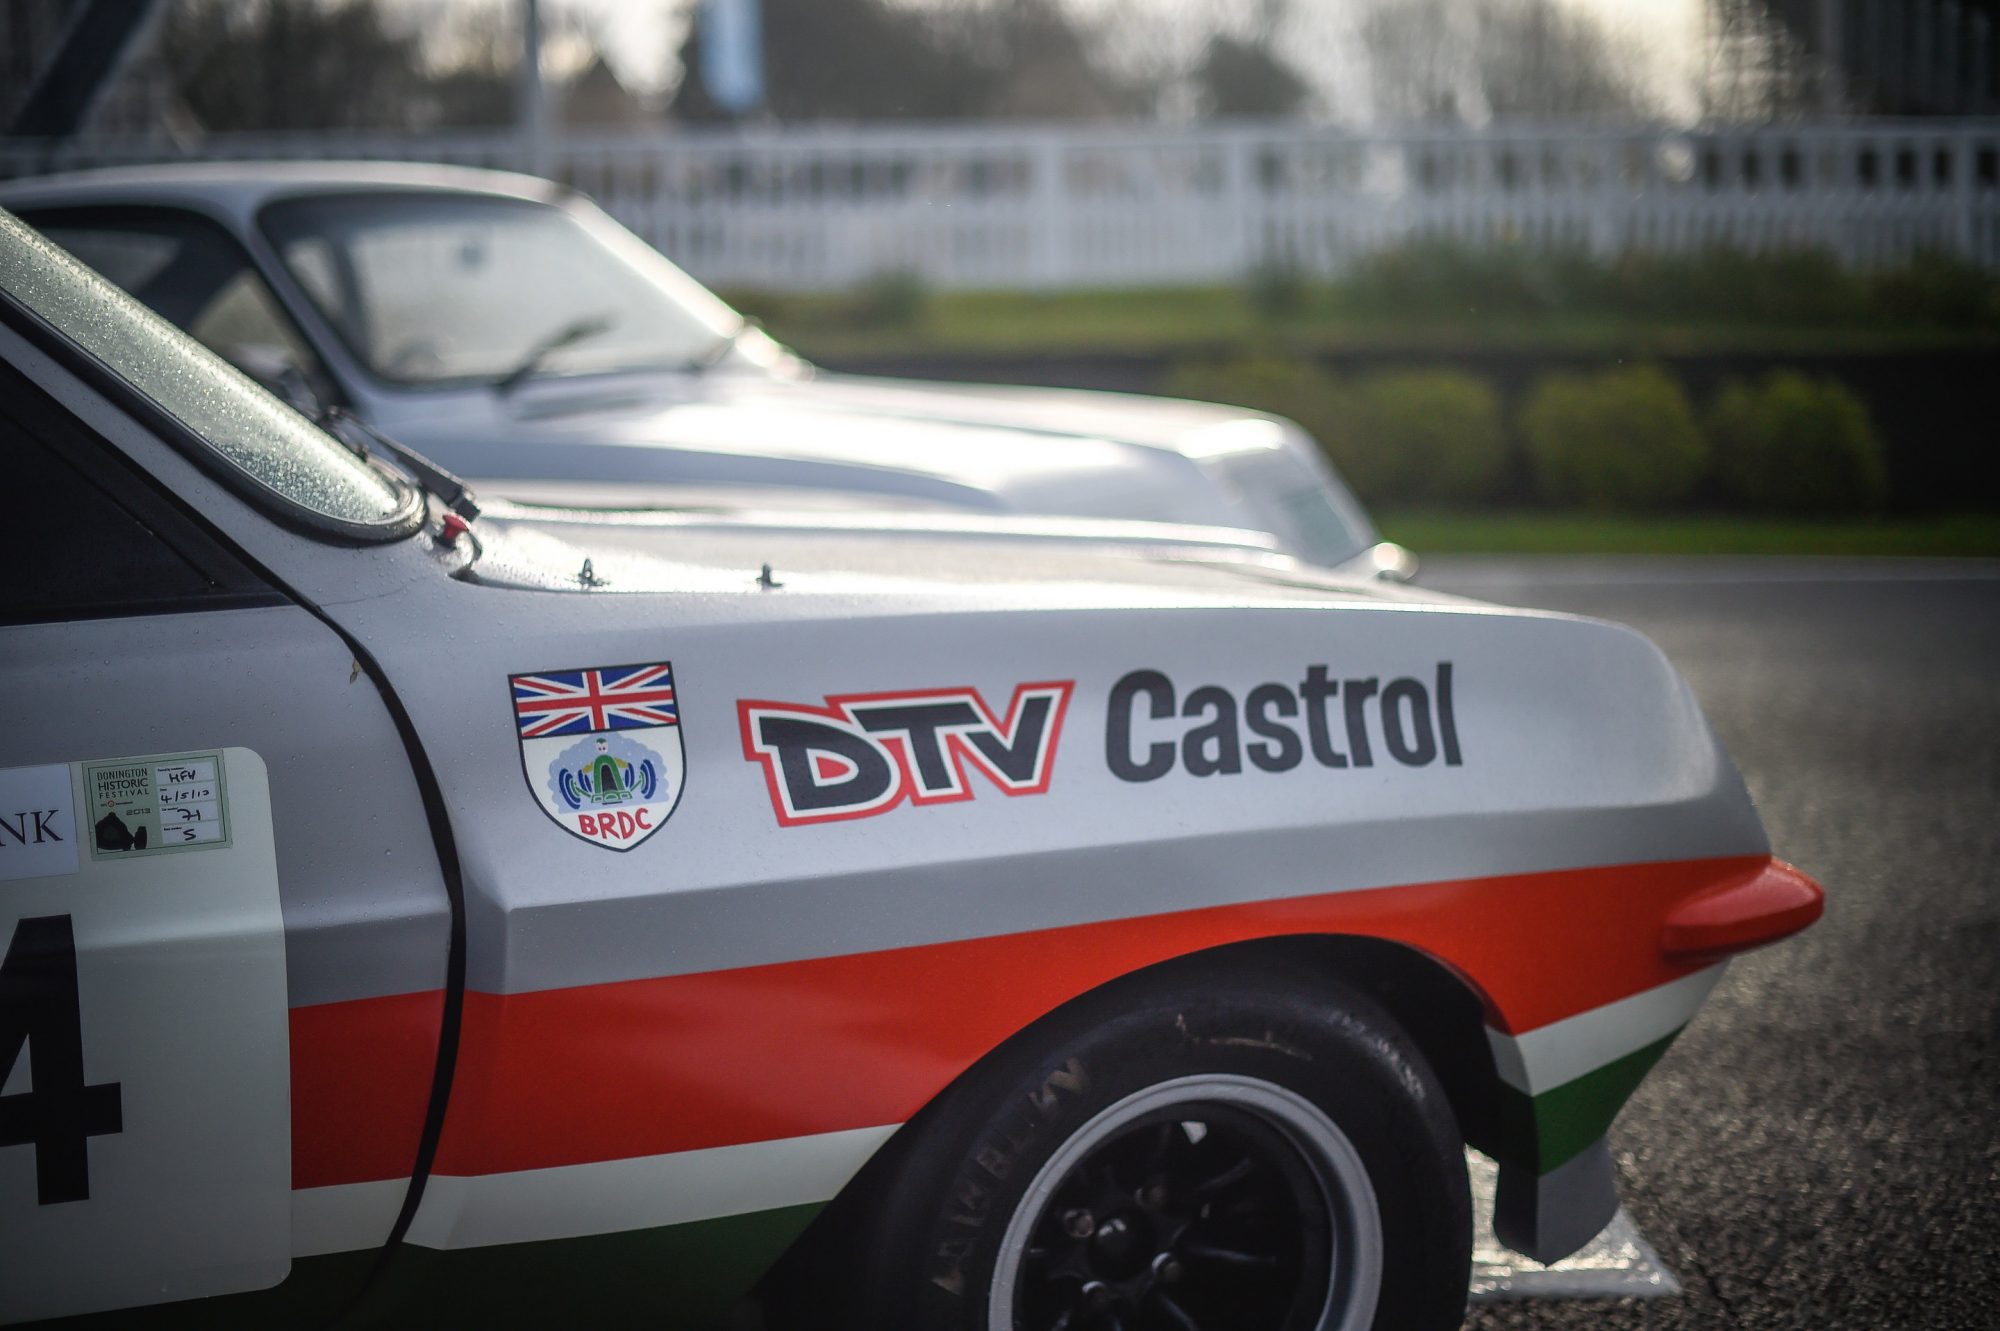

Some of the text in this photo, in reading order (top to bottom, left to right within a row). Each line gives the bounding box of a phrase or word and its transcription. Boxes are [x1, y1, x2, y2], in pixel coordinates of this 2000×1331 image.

[746, 661, 1464, 822] DTV Castrol
[96, 768, 148, 781] DONINGTON
[98, 778, 149, 791] HISTORIC
[99, 788, 150, 799] FESTIVAL
[126, 807, 151, 816] 2013
[578, 807, 652, 840] BRDC
[0, 913, 123, 1206] 4
